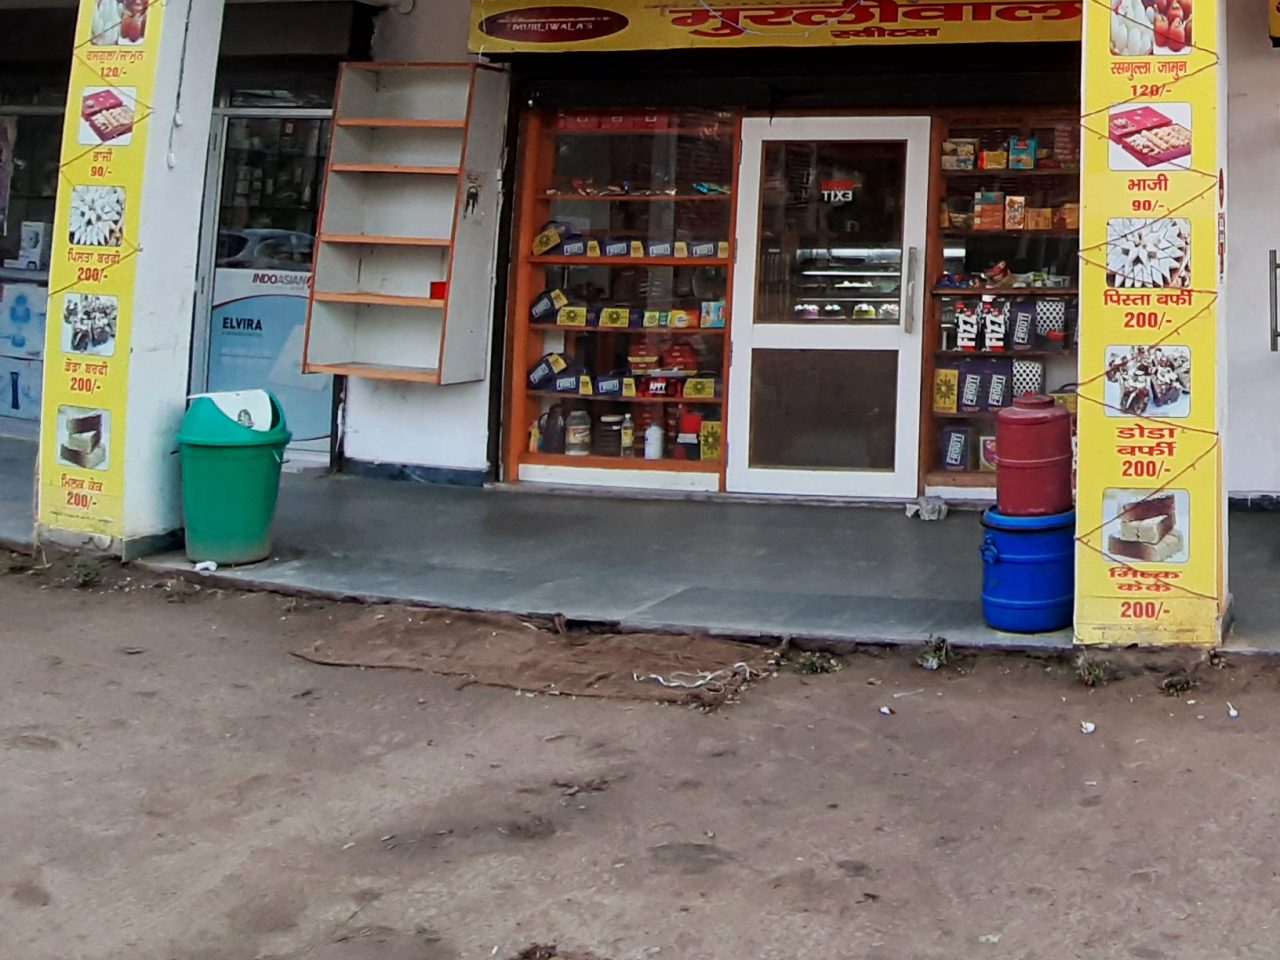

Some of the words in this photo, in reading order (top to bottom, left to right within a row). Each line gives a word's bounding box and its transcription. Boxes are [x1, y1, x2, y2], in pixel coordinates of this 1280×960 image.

[100, 67, 127, 78] 120/-
[1157, 60, 1187, 80] जामुन
[90, 166, 112, 177] 90/-
[1128, 174, 1168, 191] भाजी
[1132, 199, 1164, 212] 90/-
[77, 267, 108, 283] 200/-
[1104, 289, 1150, 306] पिस्ता
[222, 317, 262, 331] ELVIRA
[1124, 311, 1172, 330] 200/-
[70, 377, 101, 393] 200/-
[1116, 424, 1177, 439] डोडा
[1116, 441, 1176, 457] बर्फी
[1122, 460, 1171, 479] 200/-
[67, 491, 97, 510] 200/-
[1120, 601, 1170, 620] 200/-
